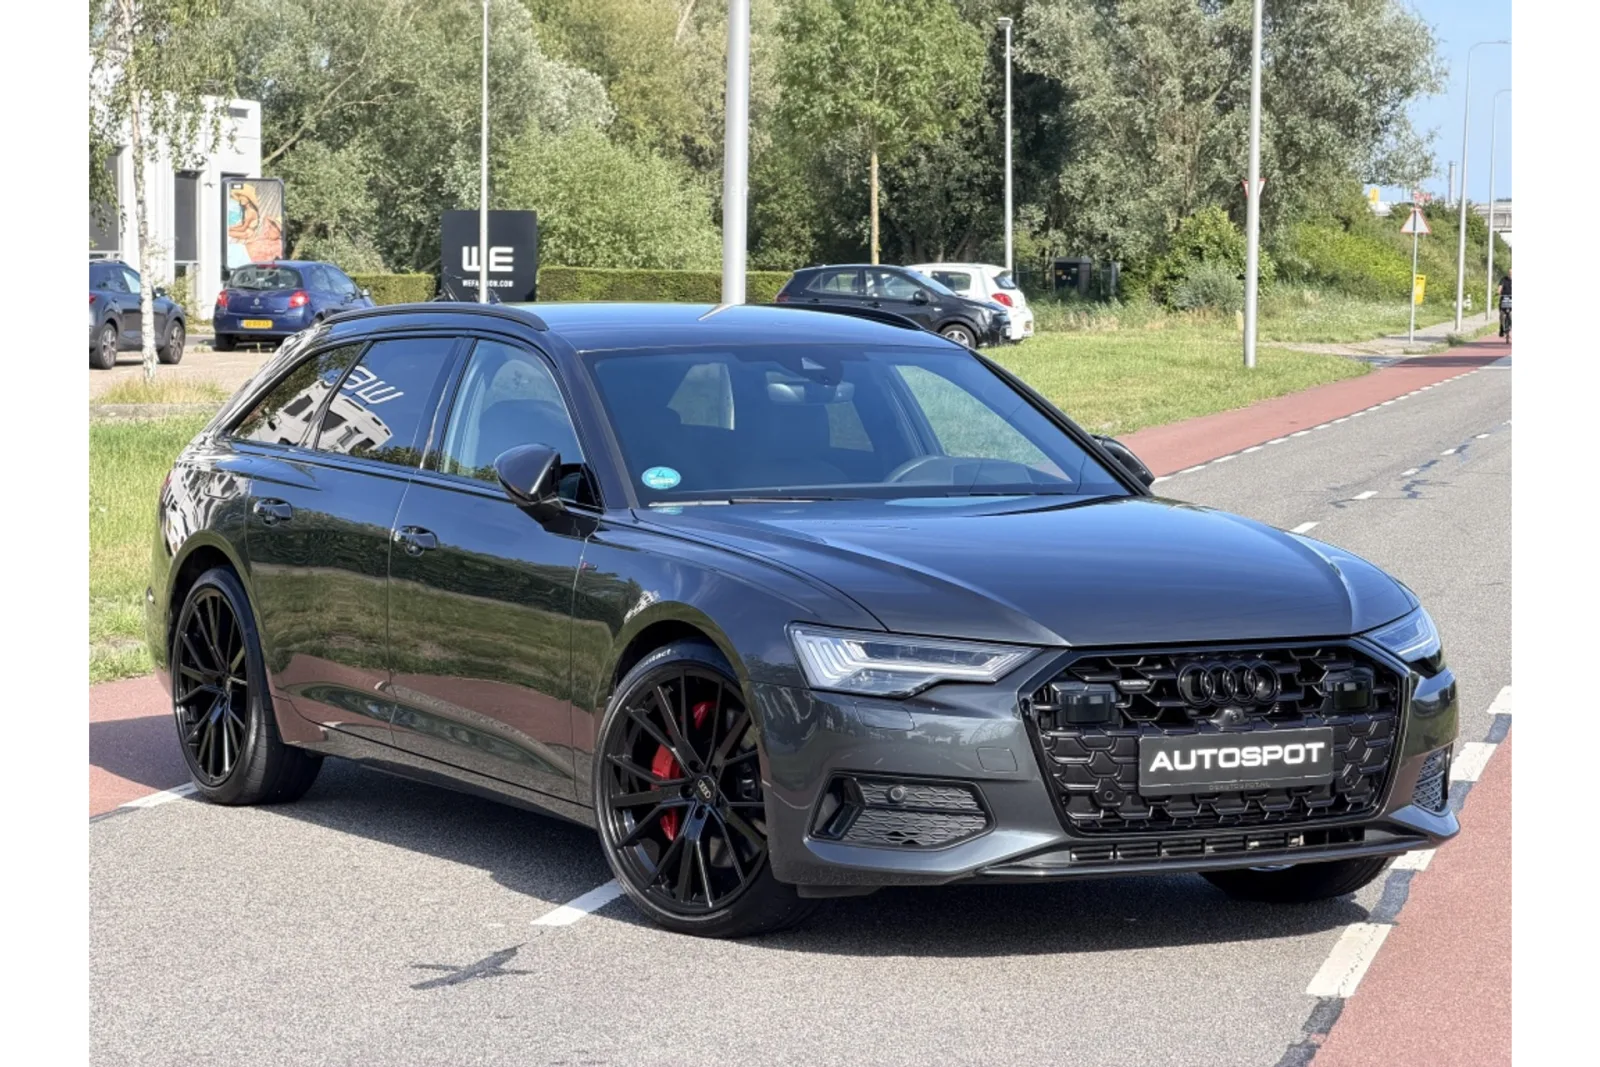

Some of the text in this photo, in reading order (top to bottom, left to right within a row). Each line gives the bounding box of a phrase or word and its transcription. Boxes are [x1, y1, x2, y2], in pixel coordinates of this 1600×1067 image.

[462, 246, 514, 272] WE
[462, 279, 514, 288] WEFAION.COM
[1149, 742, 1325, 772] AUTOSPOT
